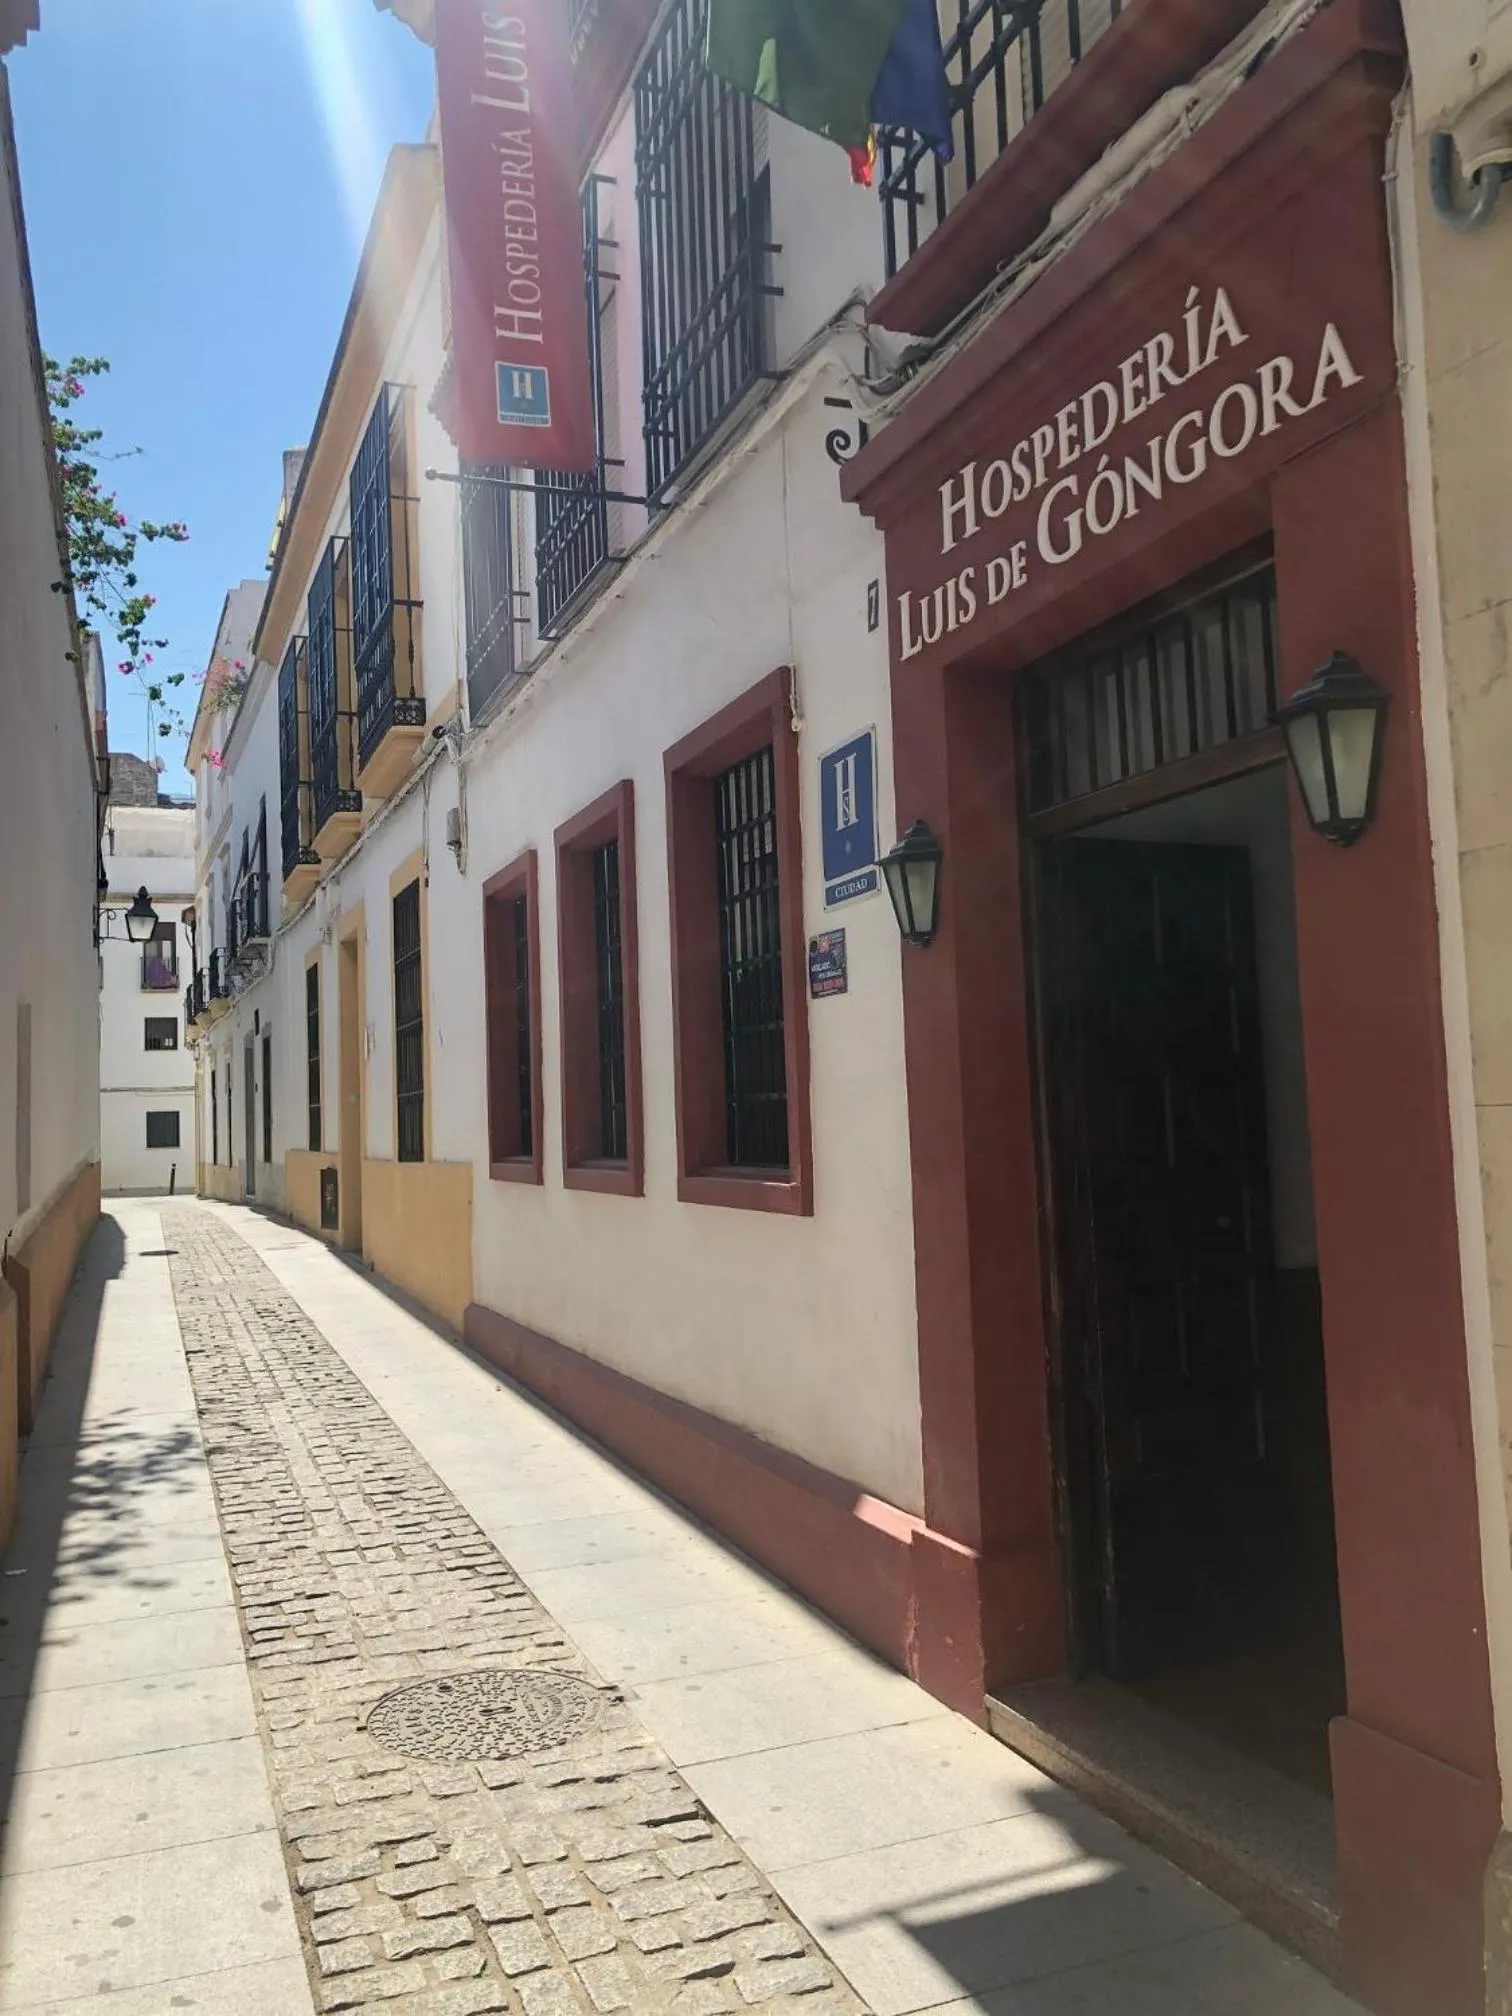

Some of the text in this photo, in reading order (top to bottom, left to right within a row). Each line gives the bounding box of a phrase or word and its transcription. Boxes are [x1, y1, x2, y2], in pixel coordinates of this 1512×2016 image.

[470, 11, 544, 345] HOSPEDERÍA LUIS
[897, 322, 1365, 661] LUIS DE GÓNGORA
[939, 284, 1250, 555] HOSPEDERÍA
[835, 878, 868, 899] CIUDAD
